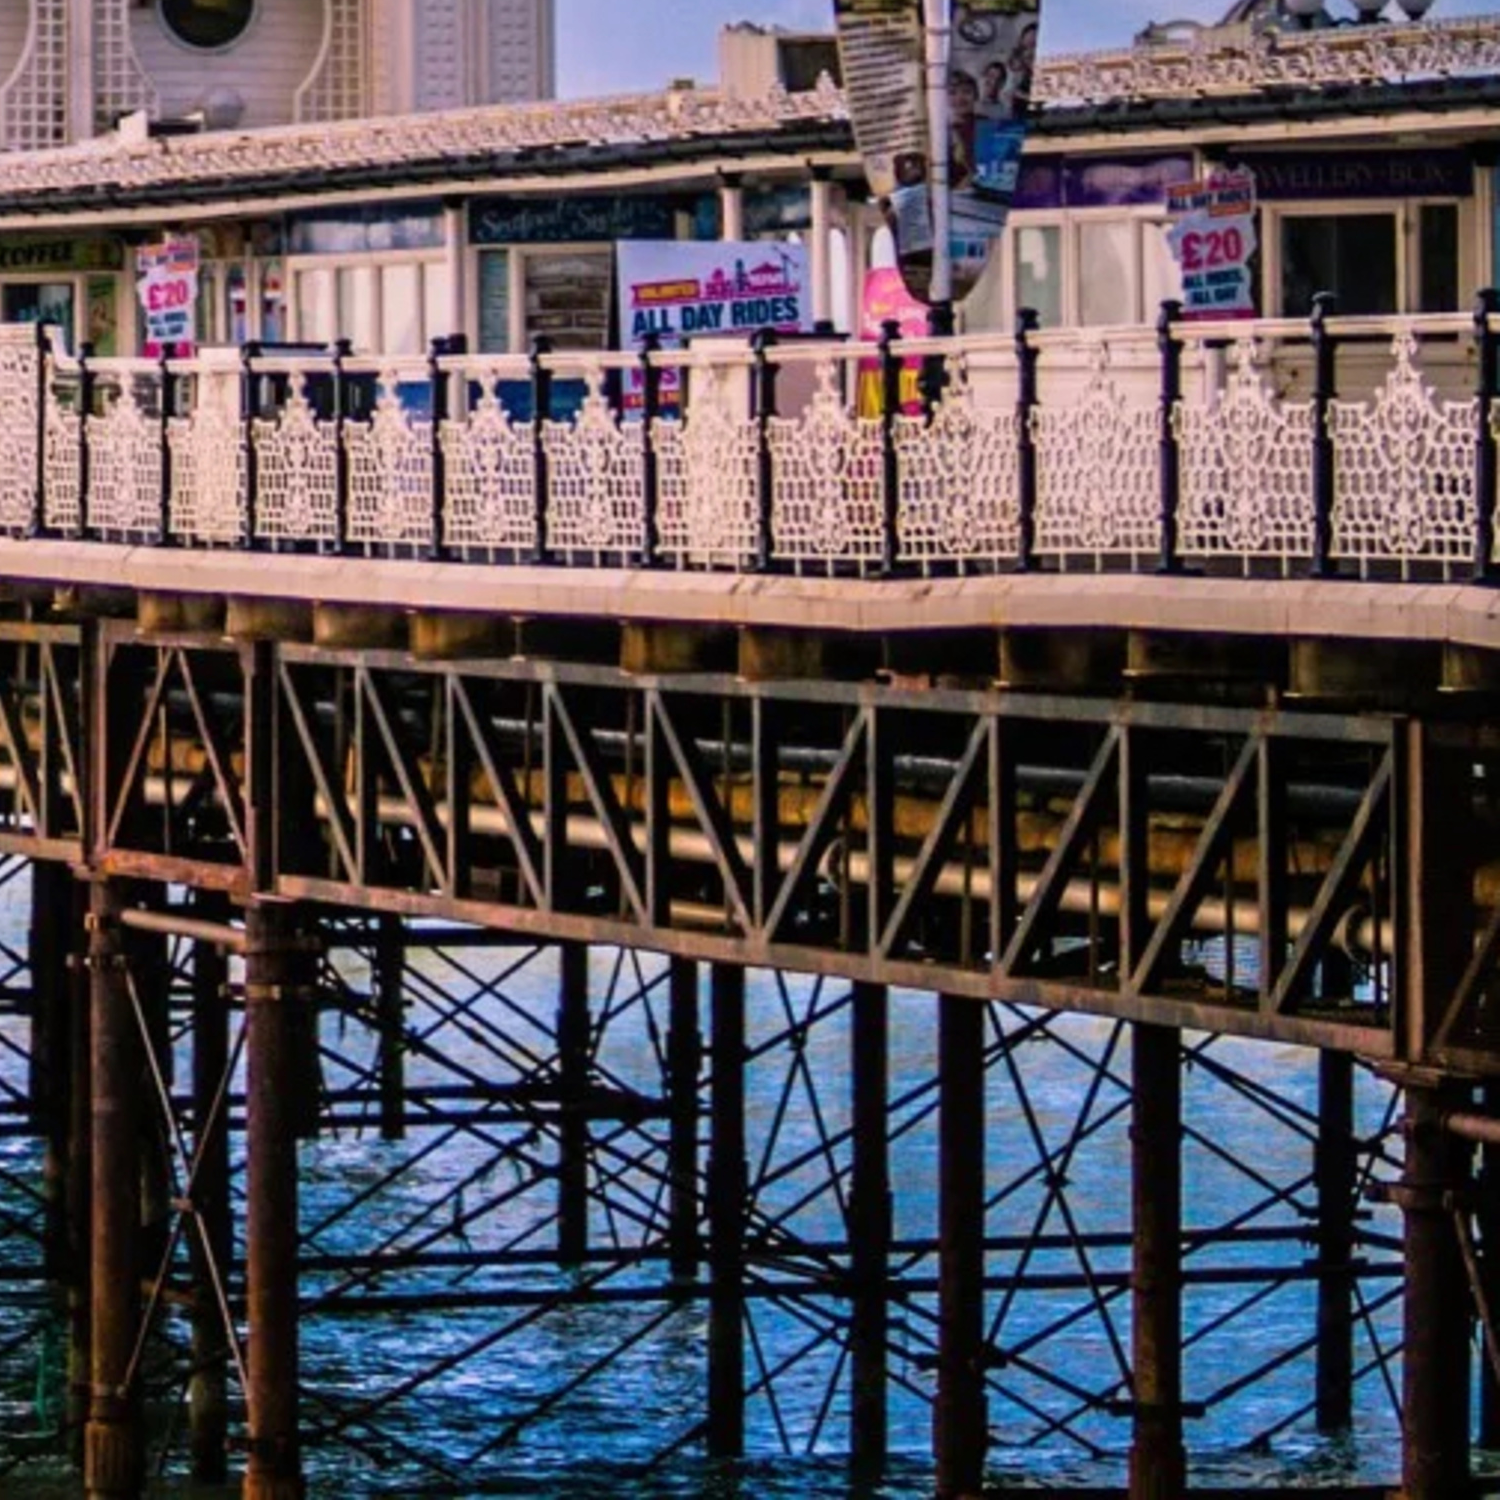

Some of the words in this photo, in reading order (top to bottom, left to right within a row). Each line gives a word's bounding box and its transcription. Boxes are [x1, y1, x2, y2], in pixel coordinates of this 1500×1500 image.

[1182, 226, 1242, 271] £20
[147, 278, 189, 312] £20
[632, 308, 674, 336] ALL
[681, 303, 725, 332] DAY
[731, 295, 799, 327] RIDES
